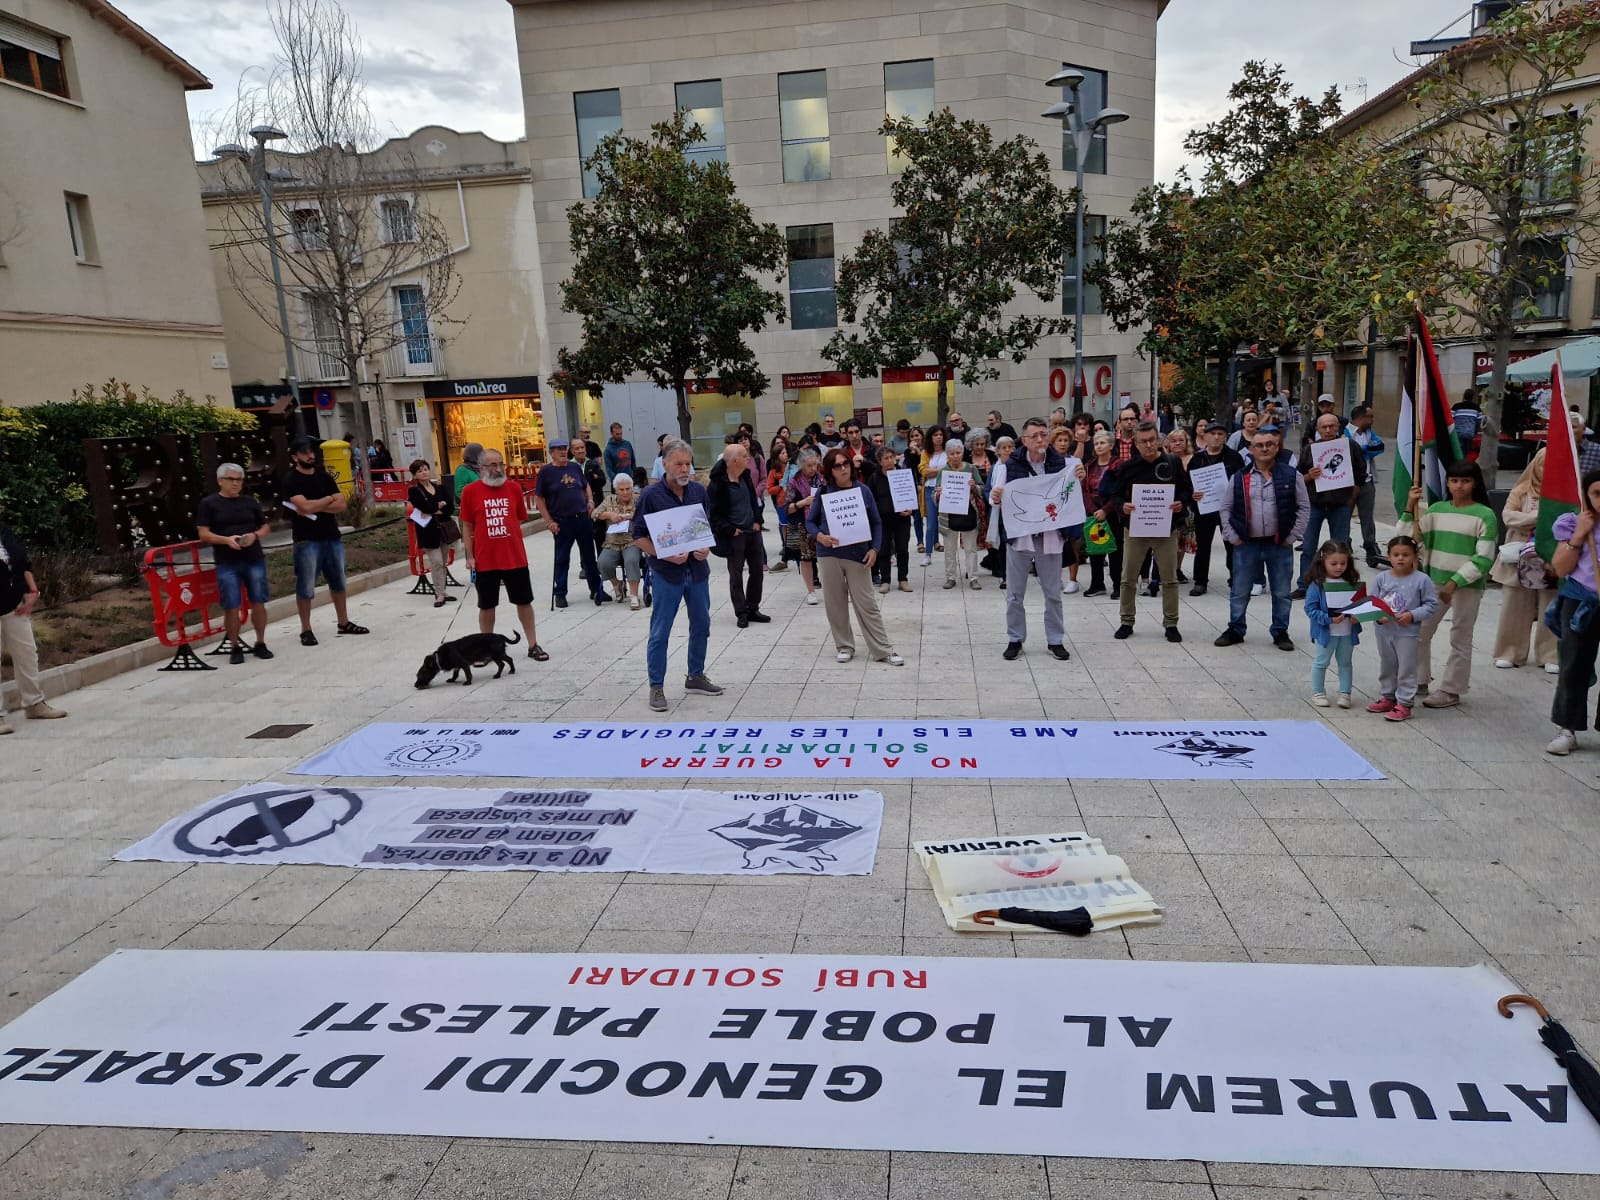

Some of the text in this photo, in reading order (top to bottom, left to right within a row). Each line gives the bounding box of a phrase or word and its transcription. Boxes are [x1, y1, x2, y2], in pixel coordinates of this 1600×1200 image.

[484, 498, 509, 508] MAKE
[485, 507, 509, 517] LOVE
[486, 517, 505, 527] NOT
[487, 526, 507, 537] WAR
[553, 727, 1079, 739] AMB ELS I LES REFUGIADES
[1113, 730, 1205, 738] Solidari
[692, 743, 929, 754] SOLIDARITAT
[640, 757, 978, 769] NO A LA GUERRA
[510, 792, 590, 806] militar
[427, 827, 483, 841] pau
[517, 827, 597, 842] volem
[549, 850, 564, 862] a
[568, 849, 609, 866] NO
[568, 966, 927, 992] RUBÍ SOLIDARI
[293, 1002, 1173, 1048] AL POBLE PALESTÍ
[0, 1047, 1568, 1123] ATUREM EL GENOCIDI D'ISRAEL
